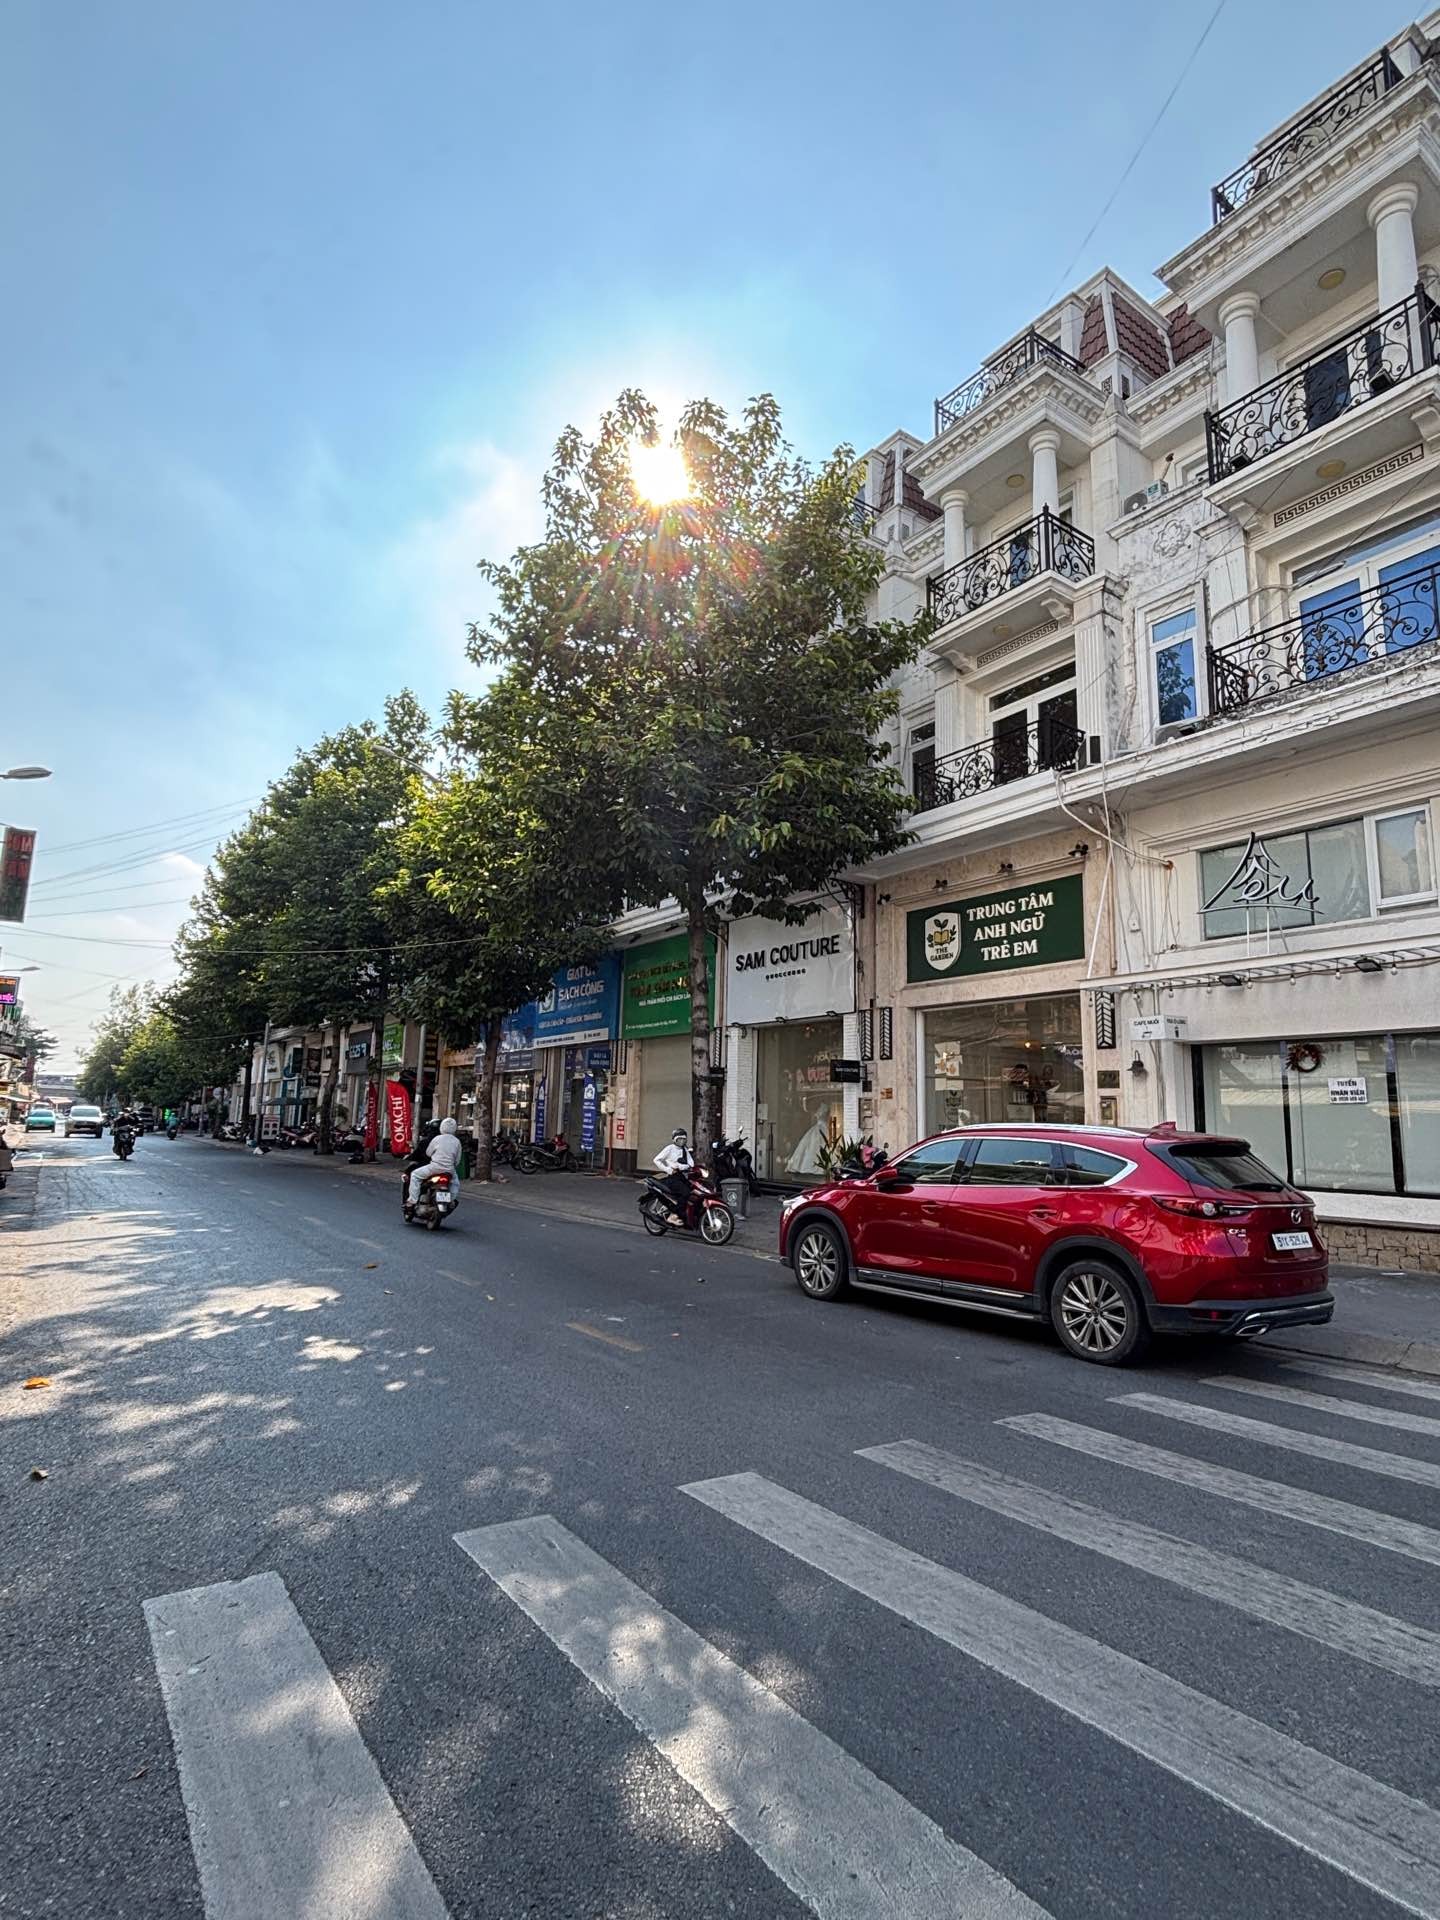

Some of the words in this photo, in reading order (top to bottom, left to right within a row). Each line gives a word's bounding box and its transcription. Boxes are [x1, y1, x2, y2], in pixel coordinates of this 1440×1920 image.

[966, 900, 1016, 922] TRUNG
[1018, 892, 1054, 912] TÂM
[973, 922, 1008, 942] ANH
[1010, 911, 1045, 934] NGỮ
[735, 950, 766, 973] SAM
[769, 934, 841, 966] COUTURE
[930, 952, 954, 962] GARDEN
[935, 947, 949, 955] THE
[981, 940, 1011, 961] TRẺ
[1013, 938, 1039, 957] EM
[391, 1096, 405, 1142] OKACHI
